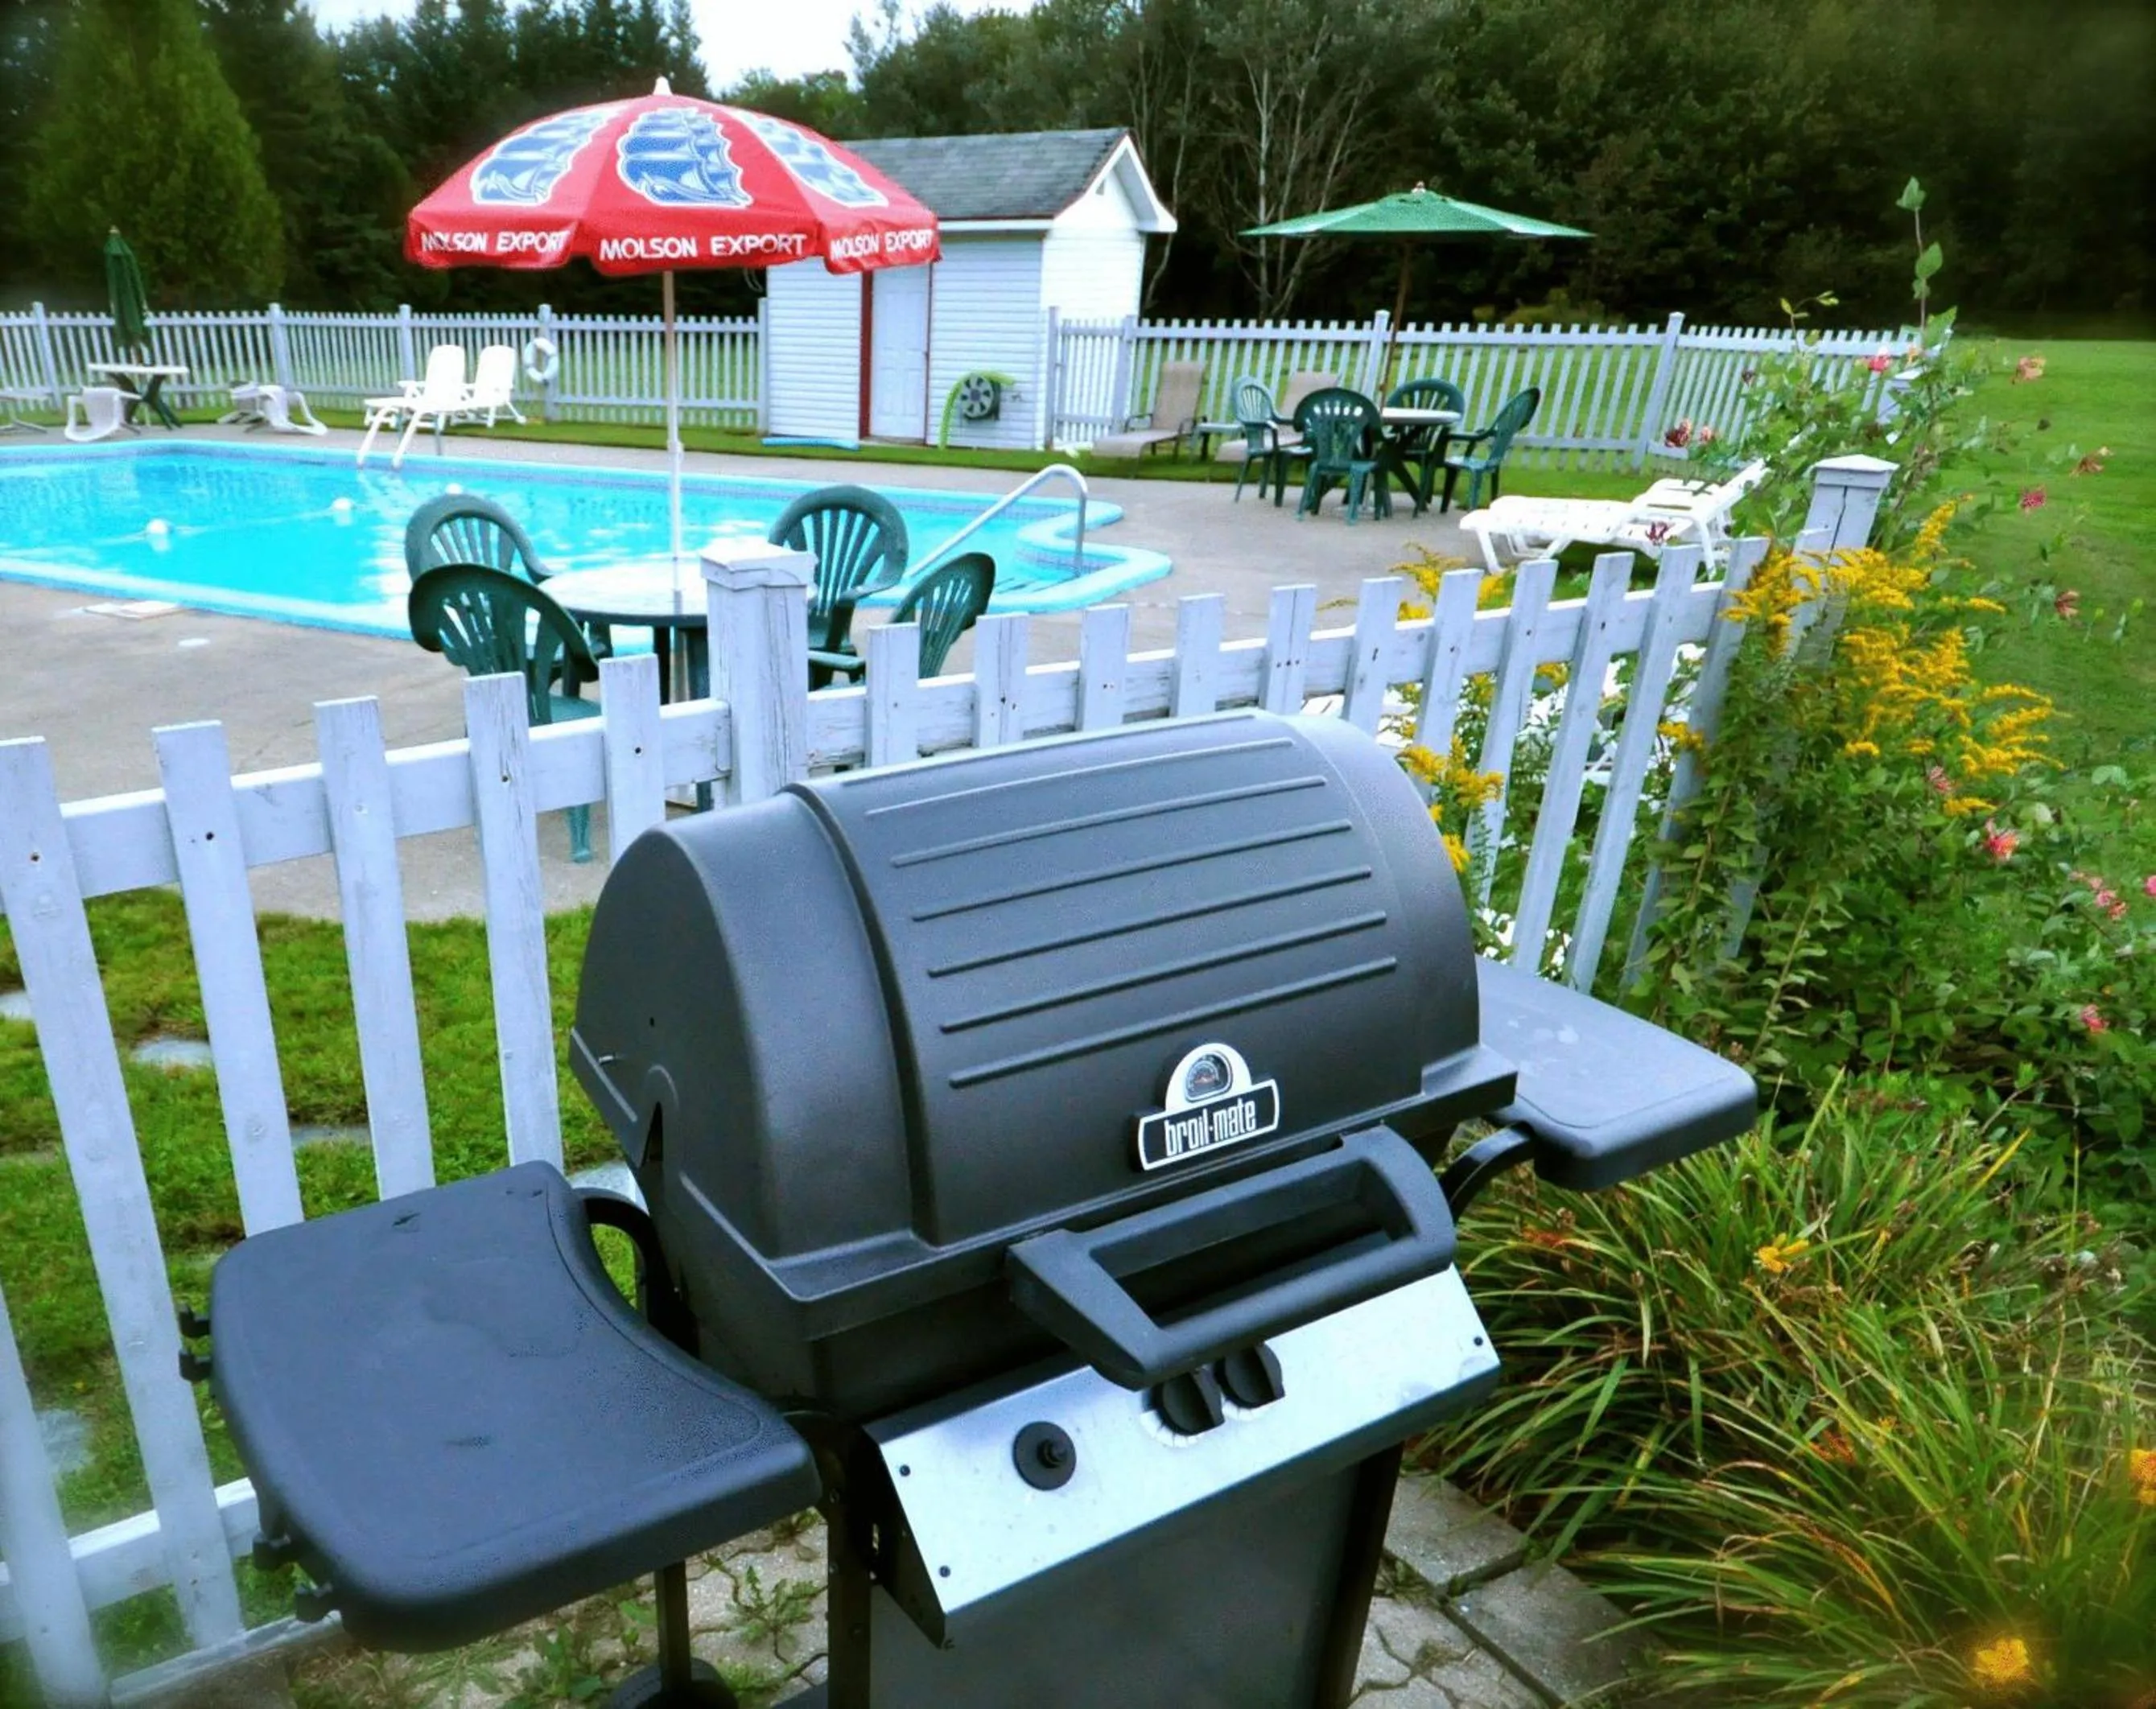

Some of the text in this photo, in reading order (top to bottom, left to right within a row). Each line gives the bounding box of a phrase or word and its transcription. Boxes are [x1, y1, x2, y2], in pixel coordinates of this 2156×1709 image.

[420, 229, 570, 253] MOLSON EXPORT
[599, 234, 806, 261] MOLSON EXPORT
[830, 229, 934, 261] MOLSON EXPORT
